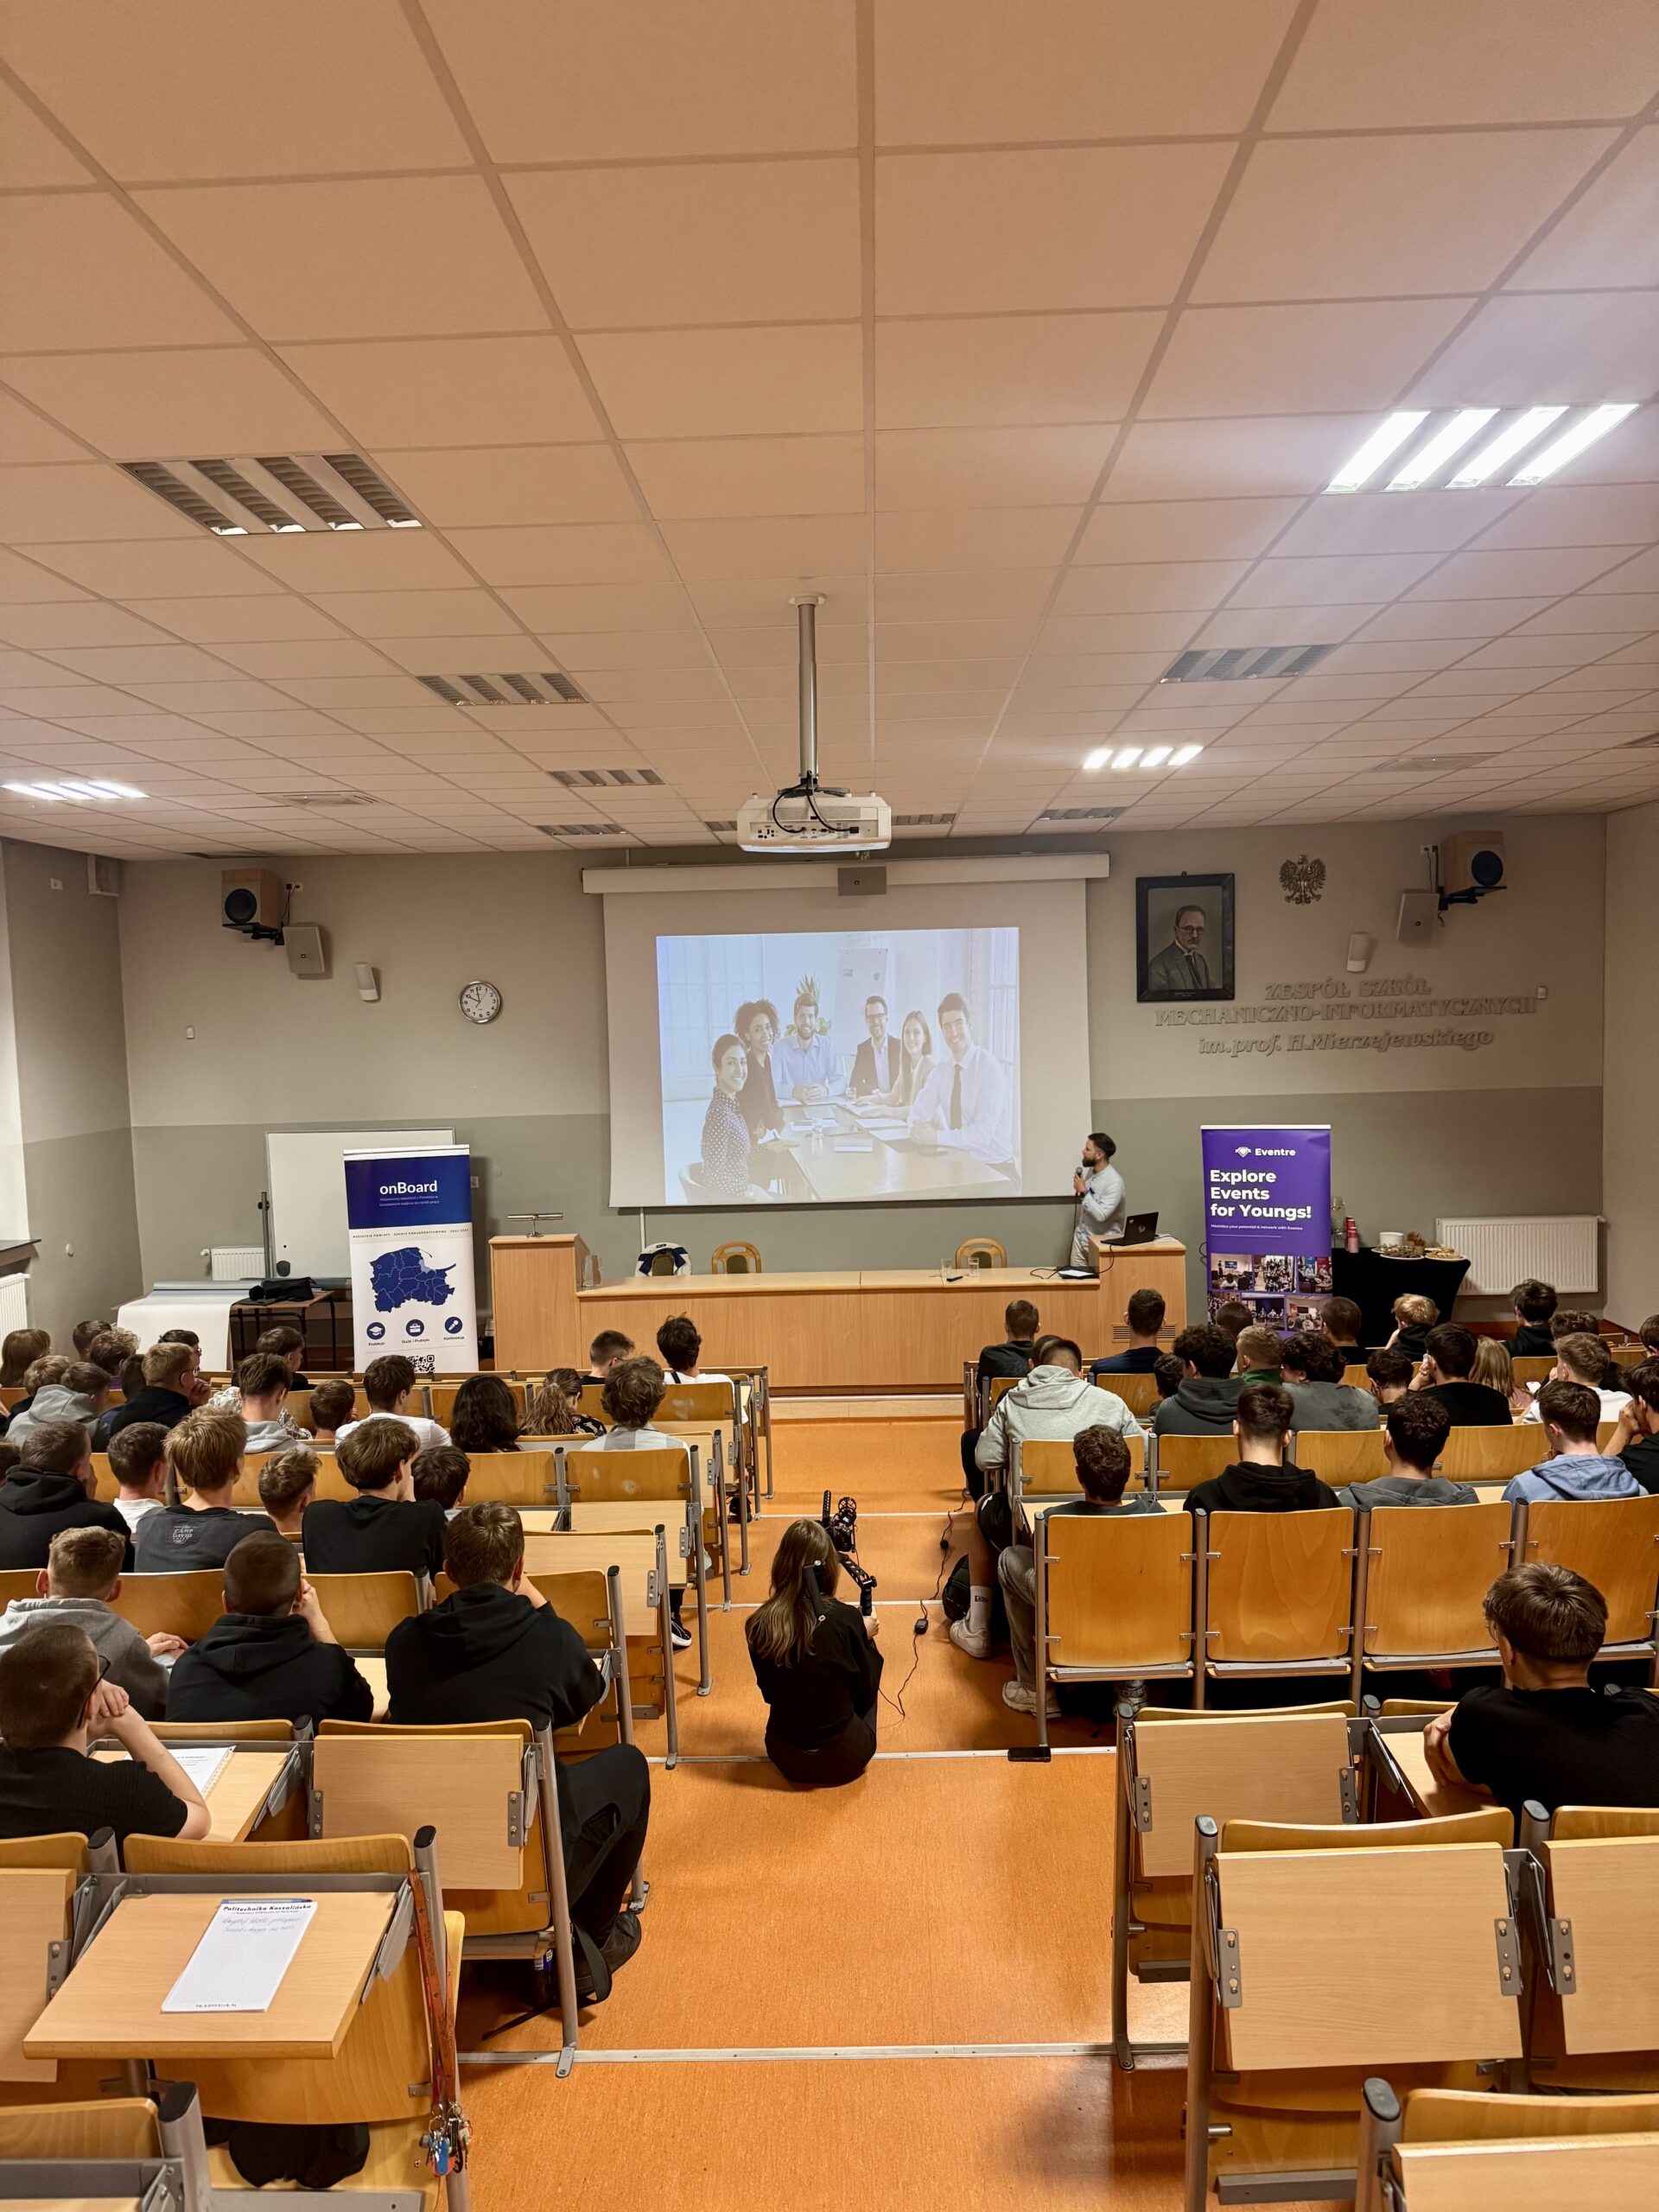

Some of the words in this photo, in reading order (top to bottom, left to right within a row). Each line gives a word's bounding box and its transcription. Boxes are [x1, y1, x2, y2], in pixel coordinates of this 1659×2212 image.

[1265, 978, 1351, 1001] ZESPÓŁ
[1359, 974, 1432, 997] SZKÓŁ
[1154, 997, 1537, 1027] MECHANICZNO-INFORMATYCZNYCH
[1255, 1147, 1296, 1157] Eventre
[1210, 1169, 1276, 1185] Explore
[379, 1179, 438, 1195] onBoard
[1211, 1186, 1270, 1200] Events
[1211, 1203, 1236, 1217] for
[1239, 1204, 1312, 1221] Youngs!
